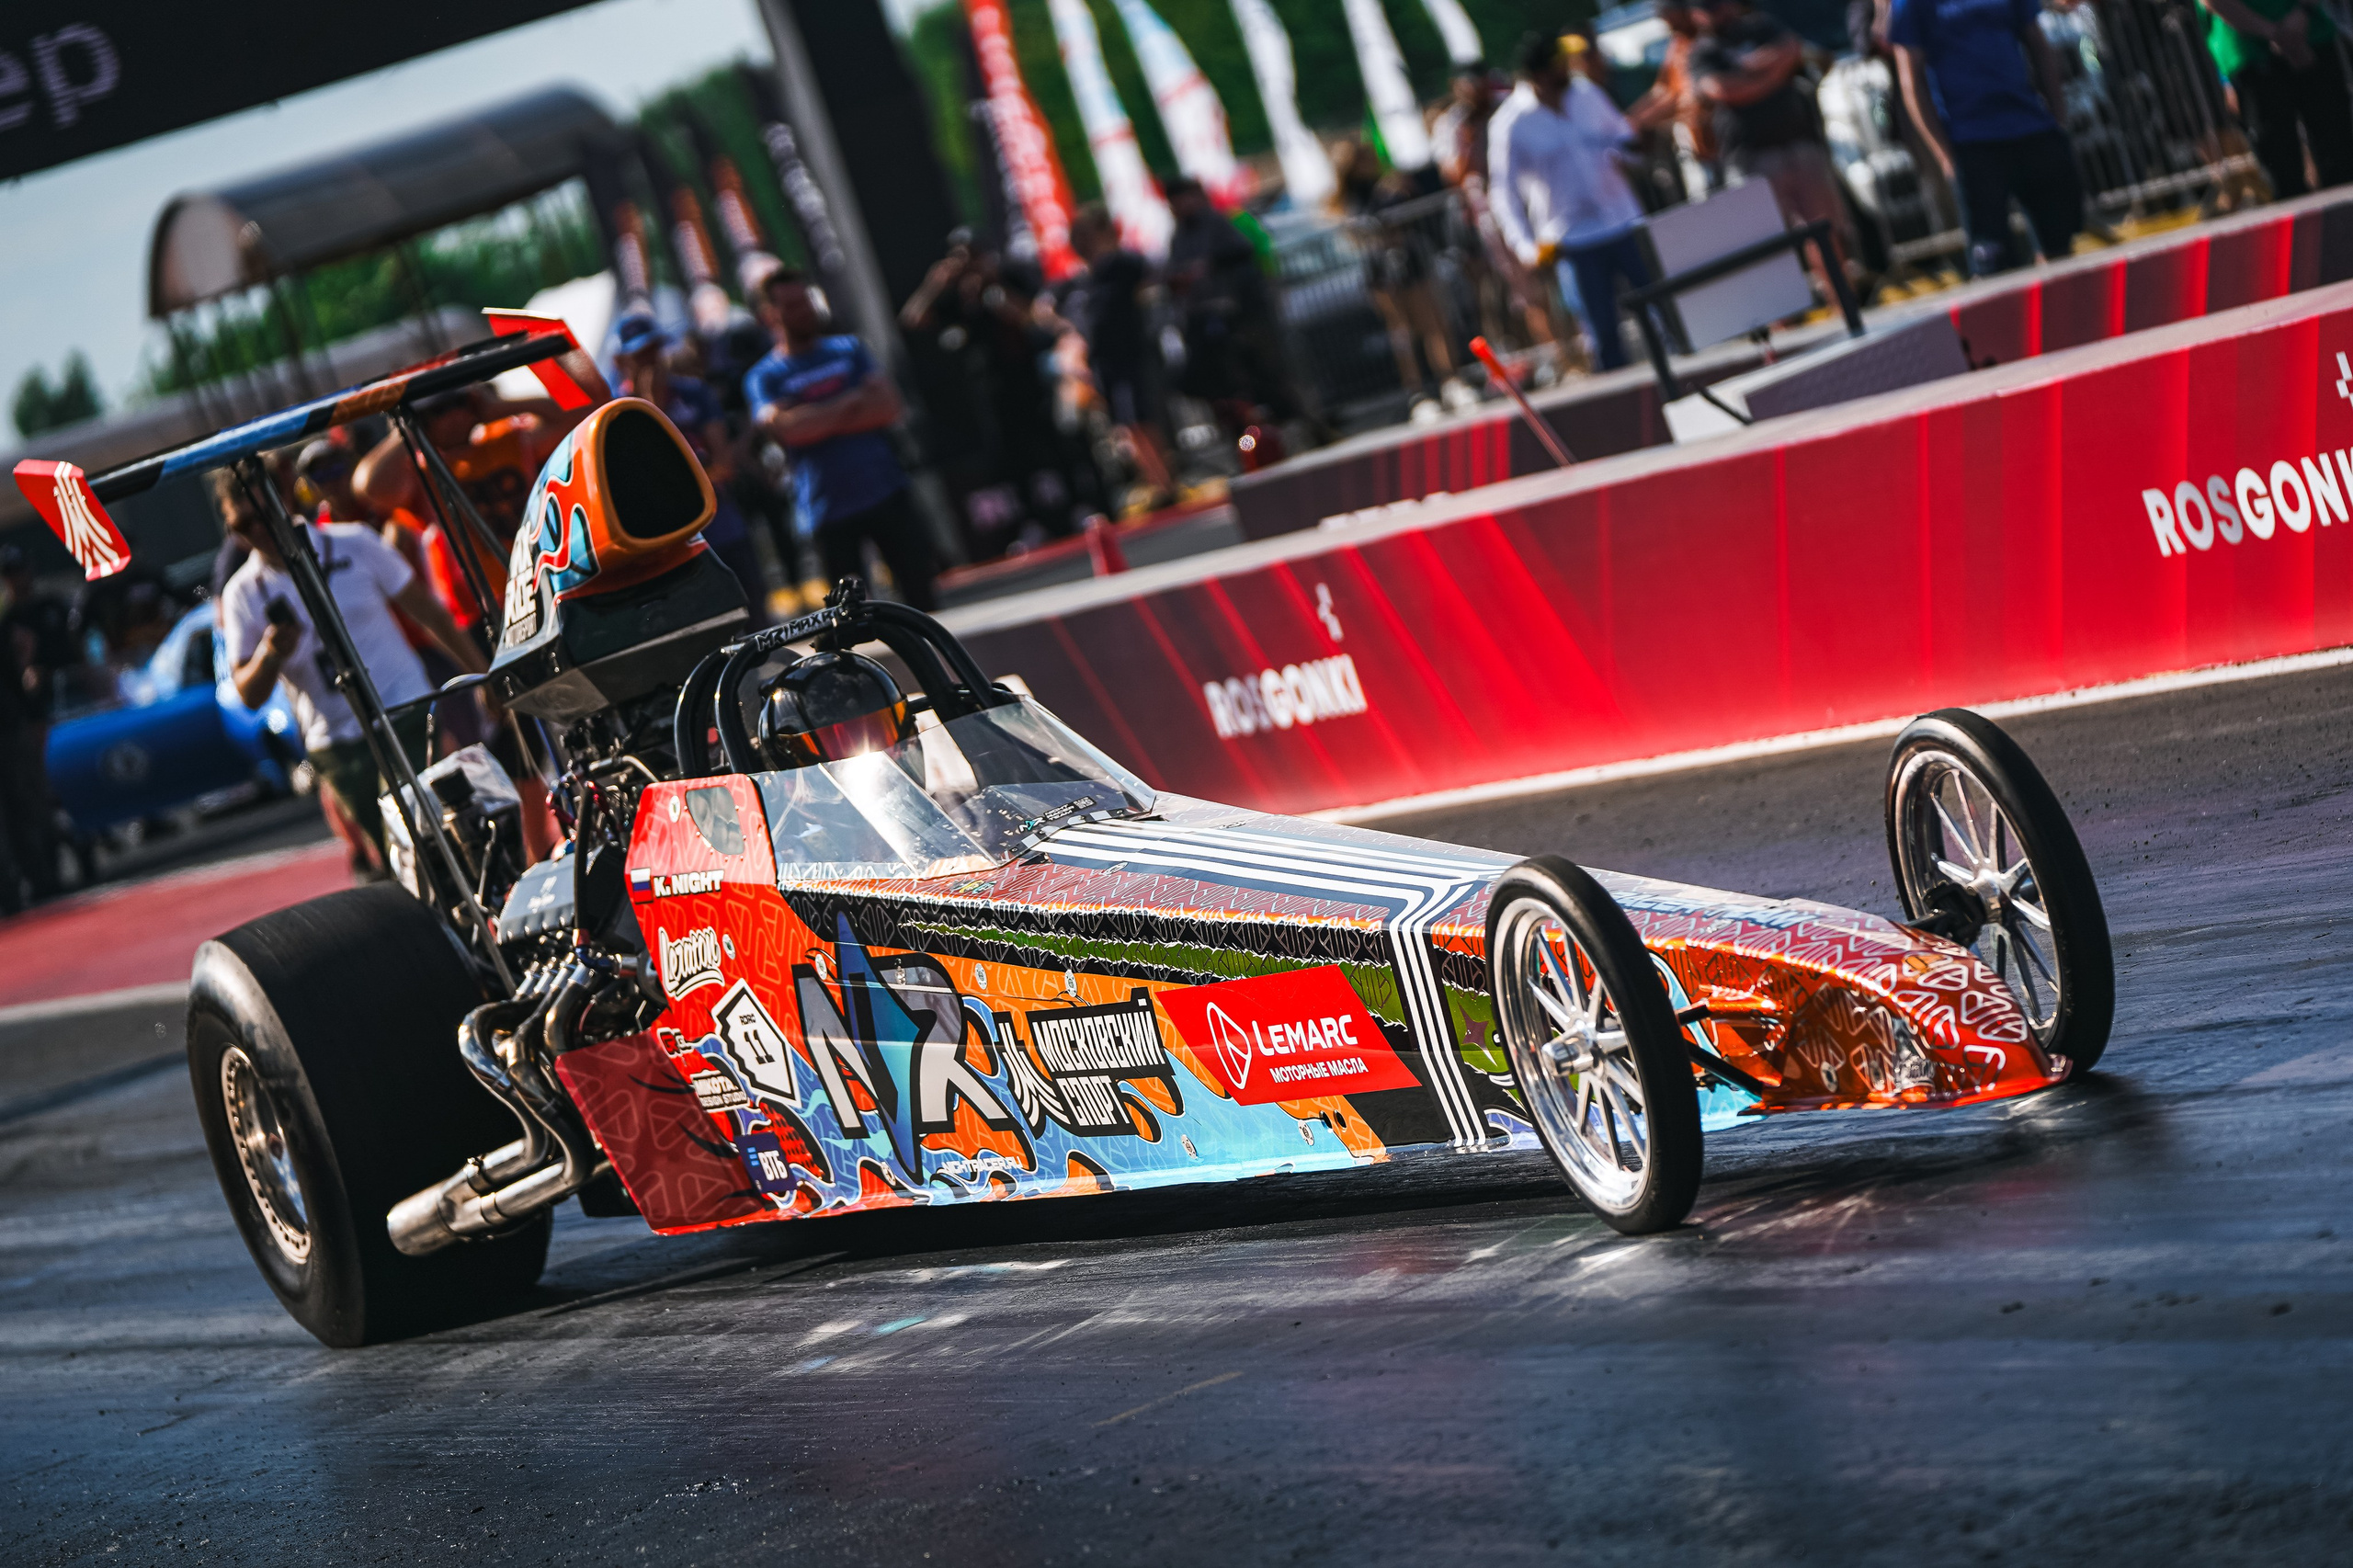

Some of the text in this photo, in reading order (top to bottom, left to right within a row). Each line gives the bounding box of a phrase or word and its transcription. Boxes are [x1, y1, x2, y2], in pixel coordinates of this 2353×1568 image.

[744, 1028, 776, 1064] 11
[1032, 998, 1166, 1074] МОСКОВСКИЙ
[1251, 1014, 1358, 1057] LEMARC
[1268, 1057, 1370, 1084] МОТОРНЫЕ МАСЛА
[1055, 1074, 1131, 1127] СПОРТ
